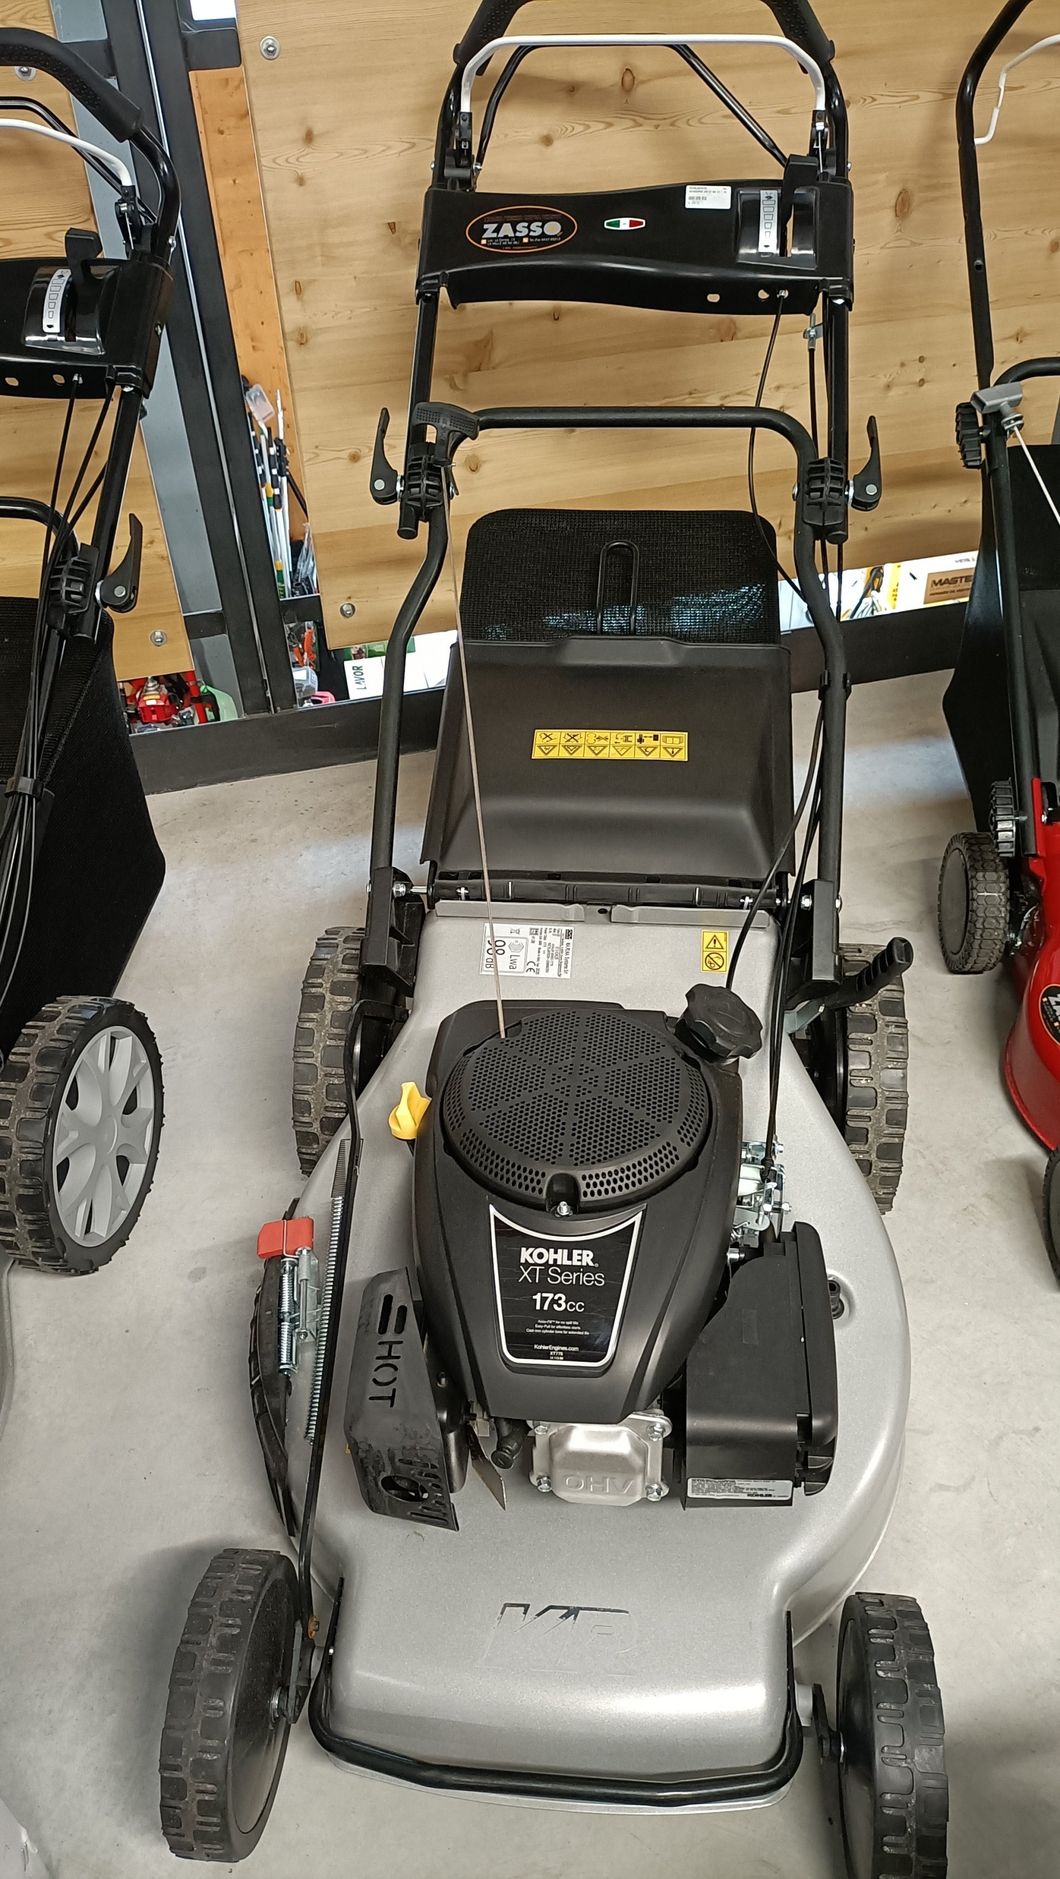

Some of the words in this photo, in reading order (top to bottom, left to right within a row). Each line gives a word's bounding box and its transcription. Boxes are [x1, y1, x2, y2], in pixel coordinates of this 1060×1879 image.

[481, 221, 562, 238] ZASSO
[519, 1247, 595, 1267] KOHLER
[518, 1265, 545, 1283] XT
[547, 1266, 605, 1287] Series
[368, 1340, 404, 1408] HOT
